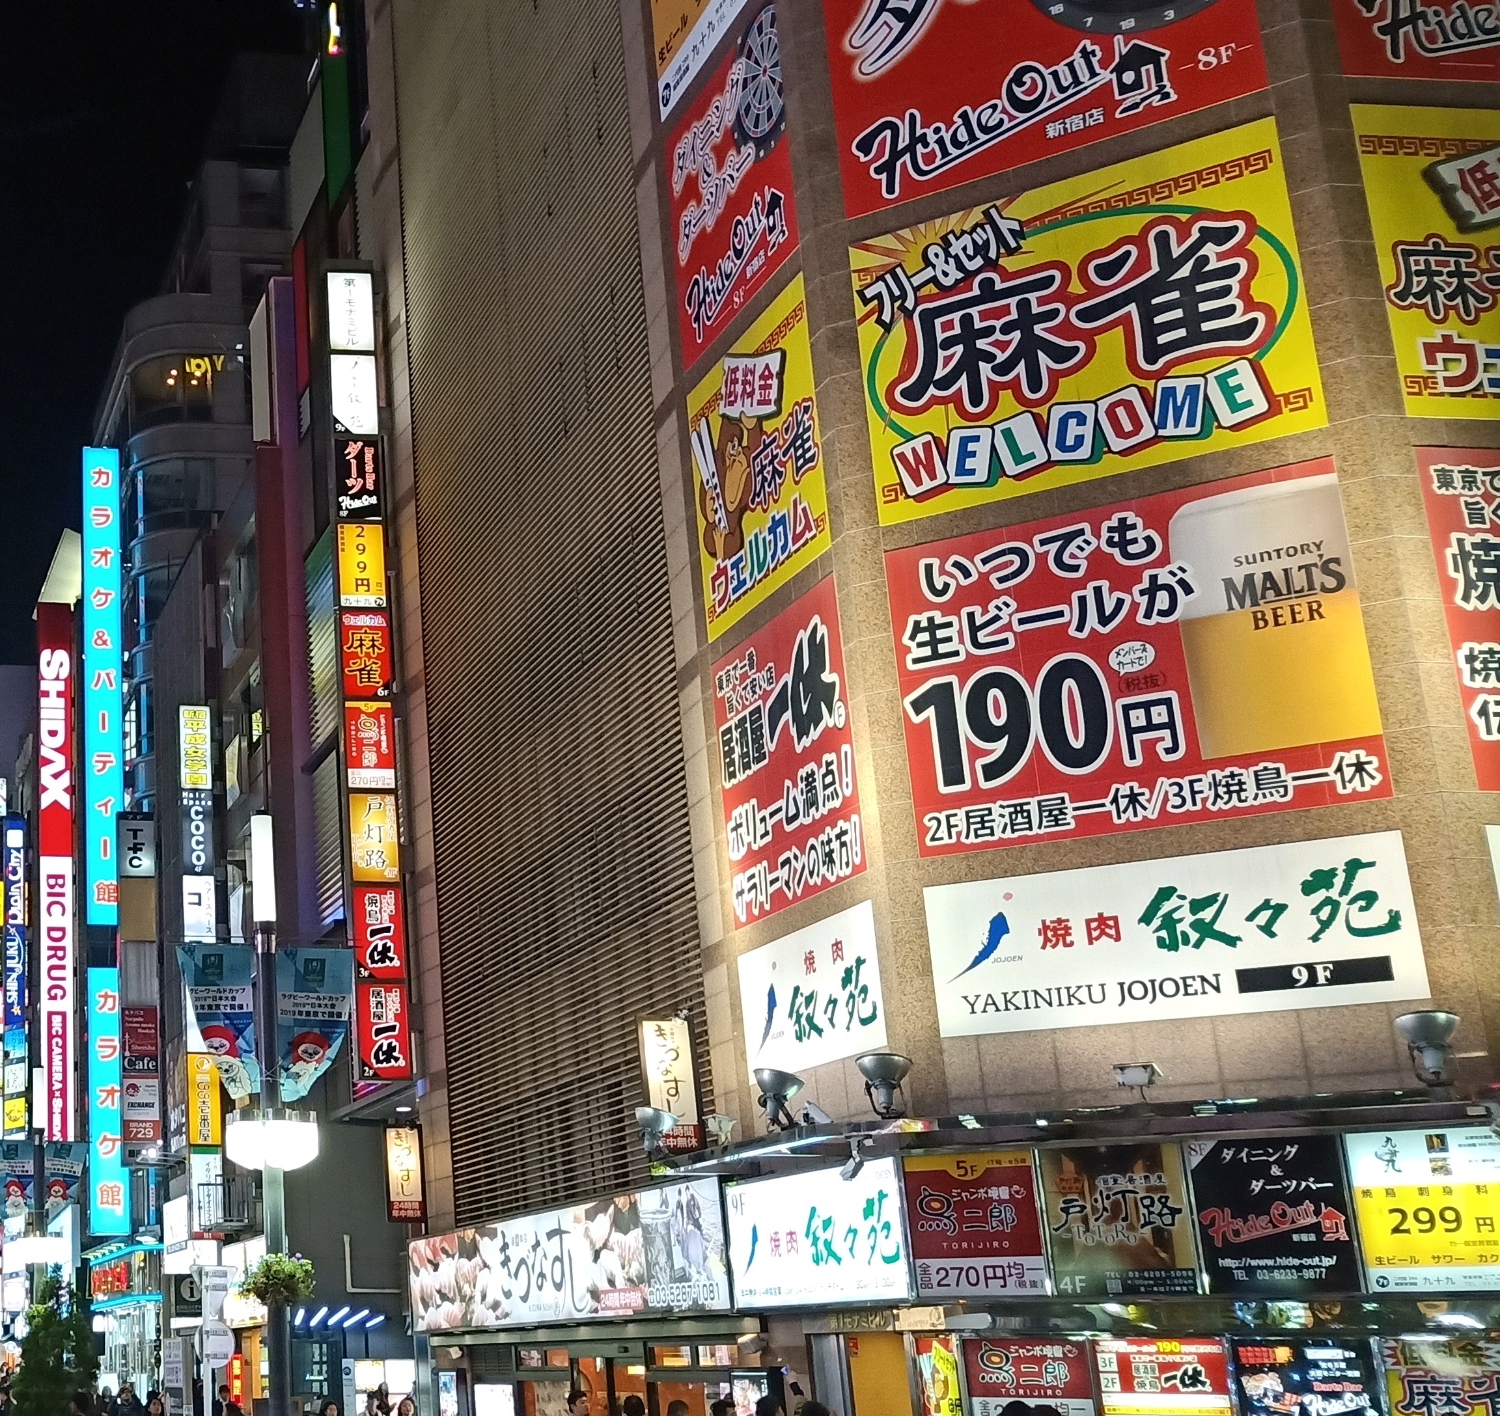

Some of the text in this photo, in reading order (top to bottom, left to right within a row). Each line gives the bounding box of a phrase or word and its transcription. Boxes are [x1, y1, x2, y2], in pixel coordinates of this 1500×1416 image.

[659, 13, 688, 66] 生ビール
[692, 21, 715, 61] 九十九
[673, 61, 744, 196] ダイニング
[1045, 108, 1105, 140] 新宿店
[680, 146, 757, 265] ダーツバー
[746, 249, 767, 280] 新宿店
[860, 207, 1024, 331] フリー&セット
[733, 285, 746, 310] 8F
[898, 216, 1264, 407] 麻雀
[724, 361, 776, 408] 低料金
[900, 364, 1258, 490] WELCOME
[345, 441, 364, 495] ダーツ
[750, 400, 817, 510] 麻雀
[354, 525, 370, 592] 299円
[709, 496, 817, 611] ウェルカム
[921, 514, 1157, 599] いつでも
[1234, 540, 1325, 568] SUNTORY
[1222, 556, 1346, 612] MALT'S
[344, 597, 372, 606] 九十九
[907, 567, 1194, 667] 生ビールが
[1252, 600, 1326, 631] BEER
[343, 614, 386, 627] ウェルカム
[344, 628, 385, 687] 麻雀
[1114, 643, 1149, 660] メンバーズ
[716, 648, 757, 696] 東京で一番
[766, 616, 838, 752] 一休
[377, 686, 389, 696] 6F
[725, 663, 776, 717] 旨くて安い店
[39, 648, 71, 810] SHIDAX
[907, 655, 1182, 790] 190円
[721, 704, 768, 787] 居酒屋
[182, 791, 206, 799] Hair
[190, 806, 206, 865] COCO
[363, 797, 388, 869] 戸灯路
[367, 894, 380, 922] 焼鳥
[1137, 857, 1403, 954] 叙々苑
[46, 873, 67, 1001] BIC DRUG
[368, 924, 397, 967] 一休
[1037, 912, 1123, 951] 焼肉
[803, 938, 844, 976] 焼肉
[991, 954, 1023, 964] JOJOEN
[358, 968, 370, 978] 3F
[1291, 962, 1335, 988] 9F
[371, 988, 384, 1022] 居酒屋
[788, 955, 877, 1043] 叙々苑
[961, 973, 1222, 1014] YAKINIKU JOJOEN
[50, 1014, 63, 1036] BIC
[373, 1022, 402, 1068] 一休
[124, 1056, 156, 1070] Cafe
[363, 1067, 375, 1077] 2F
[654, 1024, 686, 1118] きづなすし
[97, 991, 122, 1207] カラオケ館
[129, 1128, 153, 1138] 729
[956, 1160, 978, 1177] 5F
[1220, 1144, 1299, 1165] ダイニング
[1096, 1174, 1167, 1187] 個室居酒屋
[1270, 1165, 1284, 1177] &
[1250, 1179, 1334, 1196] ダーツバー
[1361, 1186, 1454, 1199] 焼鳥 刺身
[392, 1210, 421, 1218] 年中無休
[393, 1202, 419, 1210] 24時間
[1052, 1187, 1183, 1234] 戸灯路
[1388, 1206, 1463, 1236] 299
[804, 1188, 901, 1267] 叙々苑
[770, 1229, 798, 1258] 焼肉
[941, 1240, 1010, 1250] TORIJIRO
[498, 1215, 591, 1313] きづなすし
[1218, 1255, 1337, 1268] http://www.hide-out.jp/
[1233, 1268, 1327, 1281] TEL 03-6233-9877
[1374, 1254, 1466, 1265] 生ビール サワー
[1060, 1275, 1087, 1294] 4F
[1422, 1275, 1456, 1288] 九十九
[1157, 1341, 1181, 1352] 190
[1101, 1357, 1114, 1368] 3F
[1133, 1364, 1158, 1376] 居酒屋
[1162, 1366, 1209, 1390] 一休
[1001, 1388, 1063, 1397] TORIJIRO
[1103, 1378, 1118, 1389] 2F
[1136, 1380, 1160, 1390] 焼鳥
